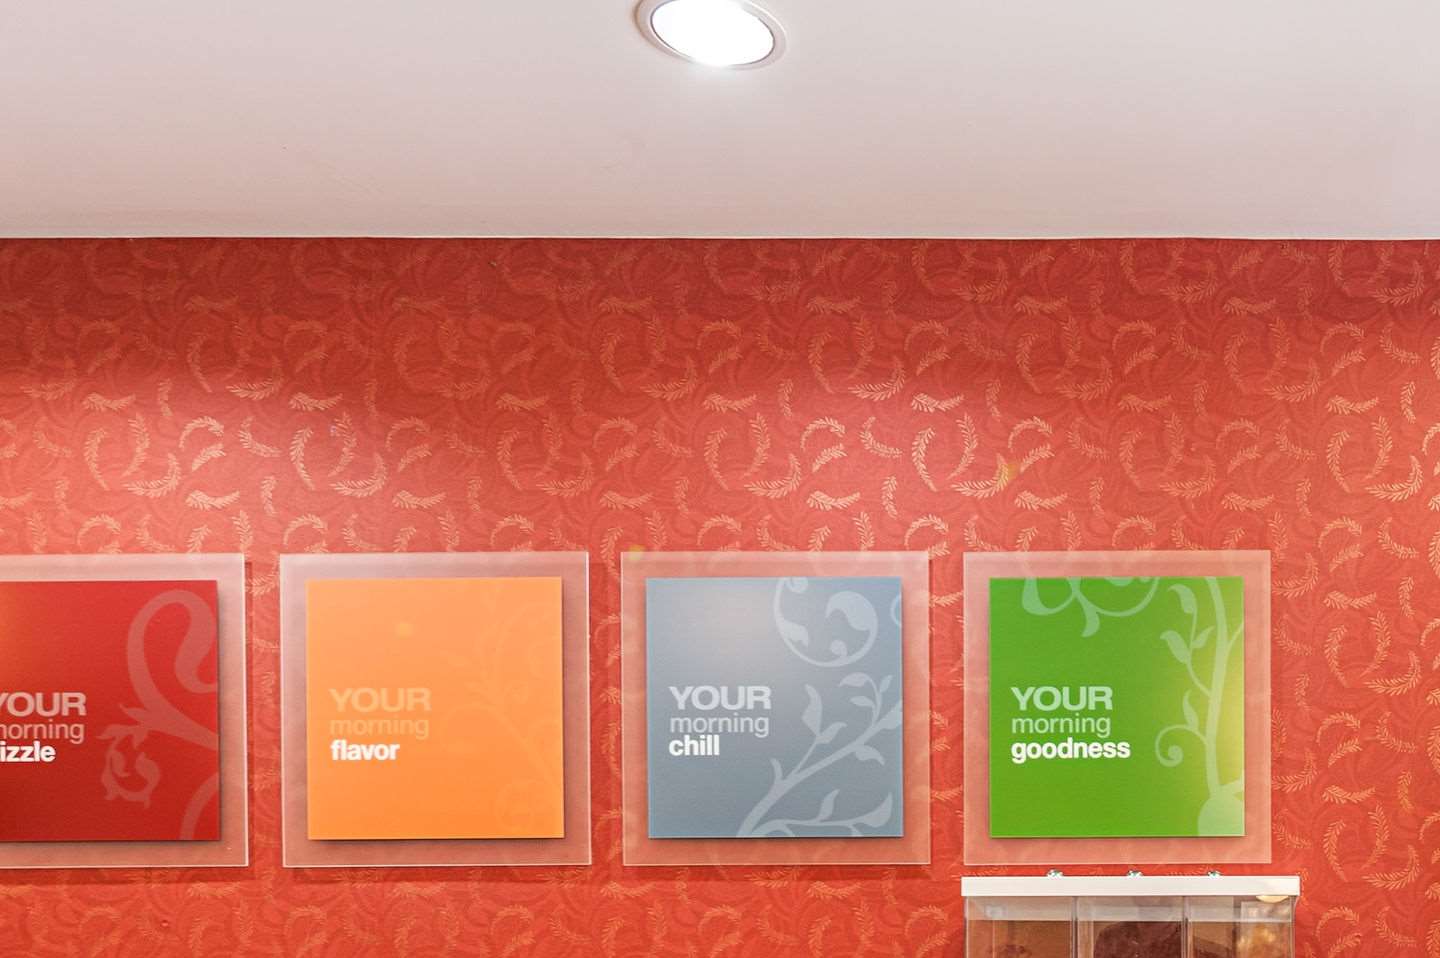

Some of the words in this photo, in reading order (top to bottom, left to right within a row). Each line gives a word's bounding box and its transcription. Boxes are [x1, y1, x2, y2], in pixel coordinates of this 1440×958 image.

[327, 687, 432, 713] YOUR
[668, 685, 772, 711] YOUR
[1010, 685, 1113, 712] YOUR
[330, 714, 430, 741] morning
[669, 712, 770, 738] morning
[1011, 712, 1111, 739] morning
[330, 738, 401, 761] flavor
[668, 734, 720, 756] chill
[1011, 736, 1131, 765] goodness
